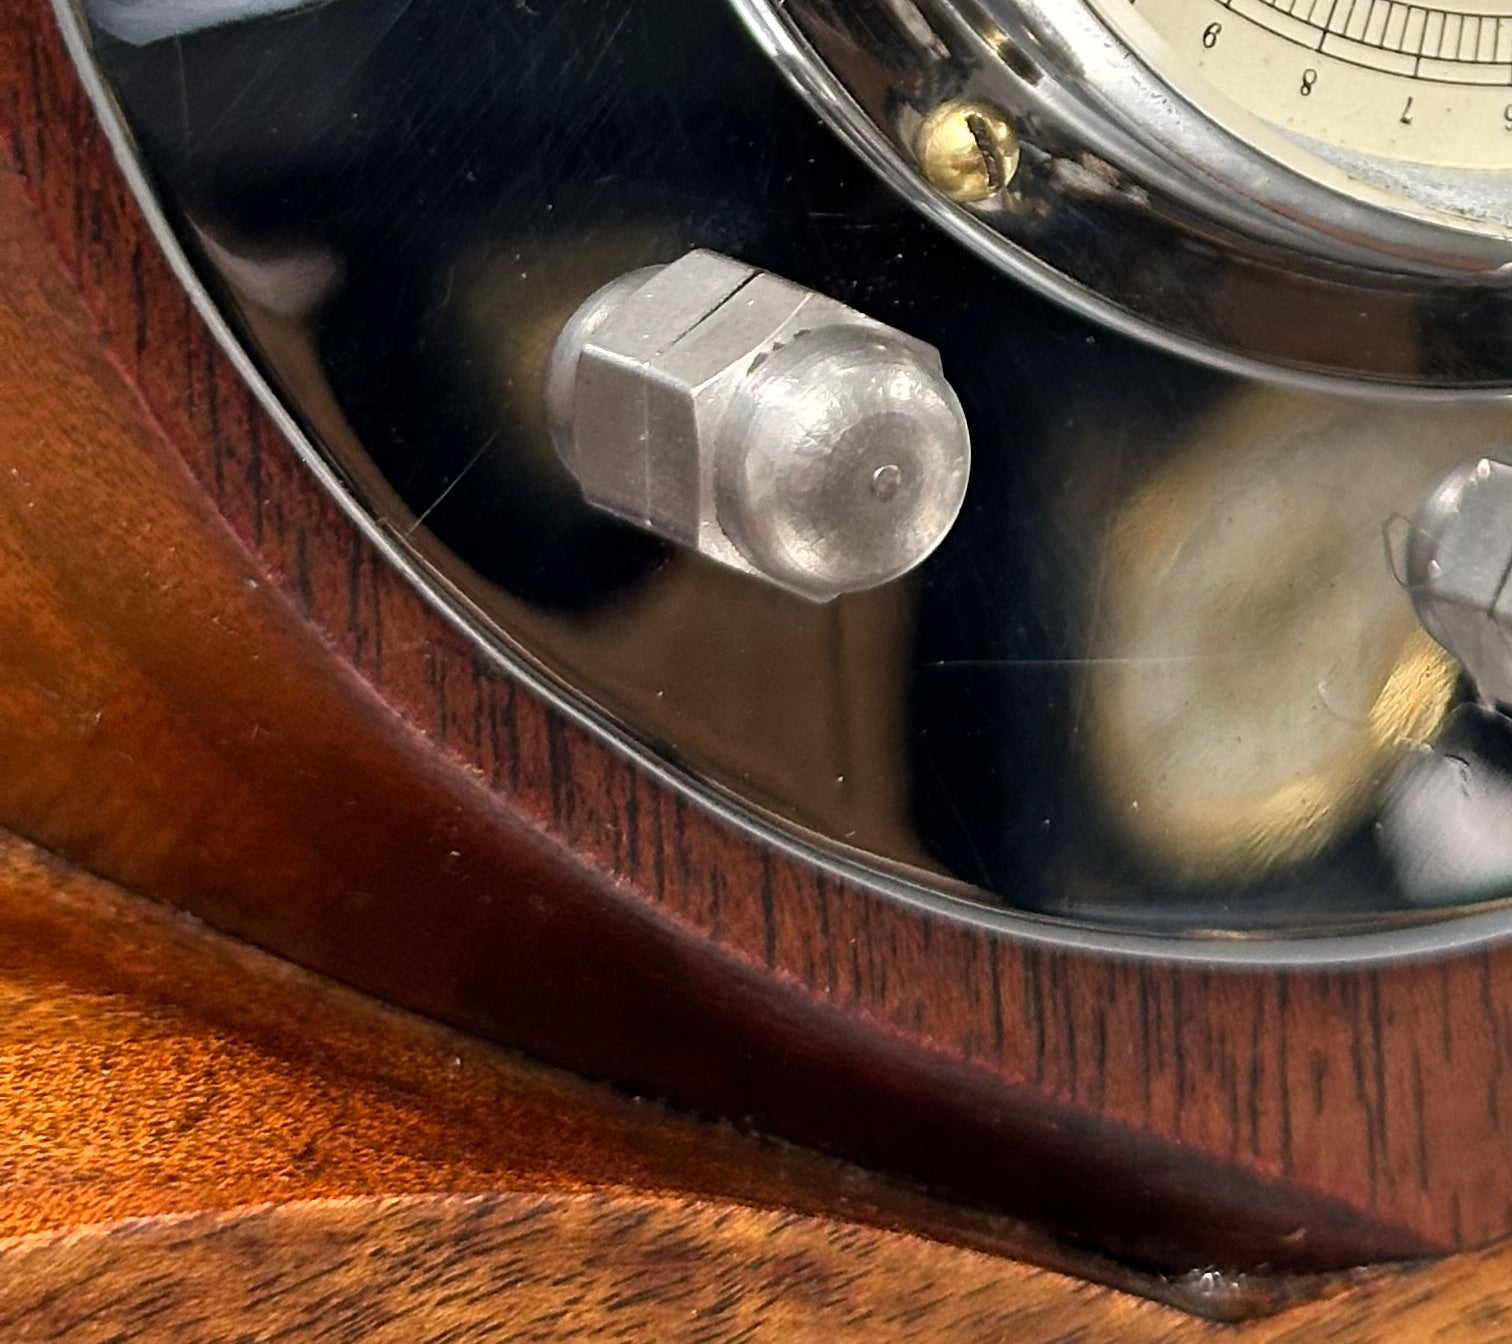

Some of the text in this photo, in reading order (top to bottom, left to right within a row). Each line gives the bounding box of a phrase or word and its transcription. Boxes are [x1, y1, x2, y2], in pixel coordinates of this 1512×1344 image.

[1202, 22, 1222, 50] 9
[1299, 68, 1318, 97] 8
[1400, 97, 1415, 126] 7
